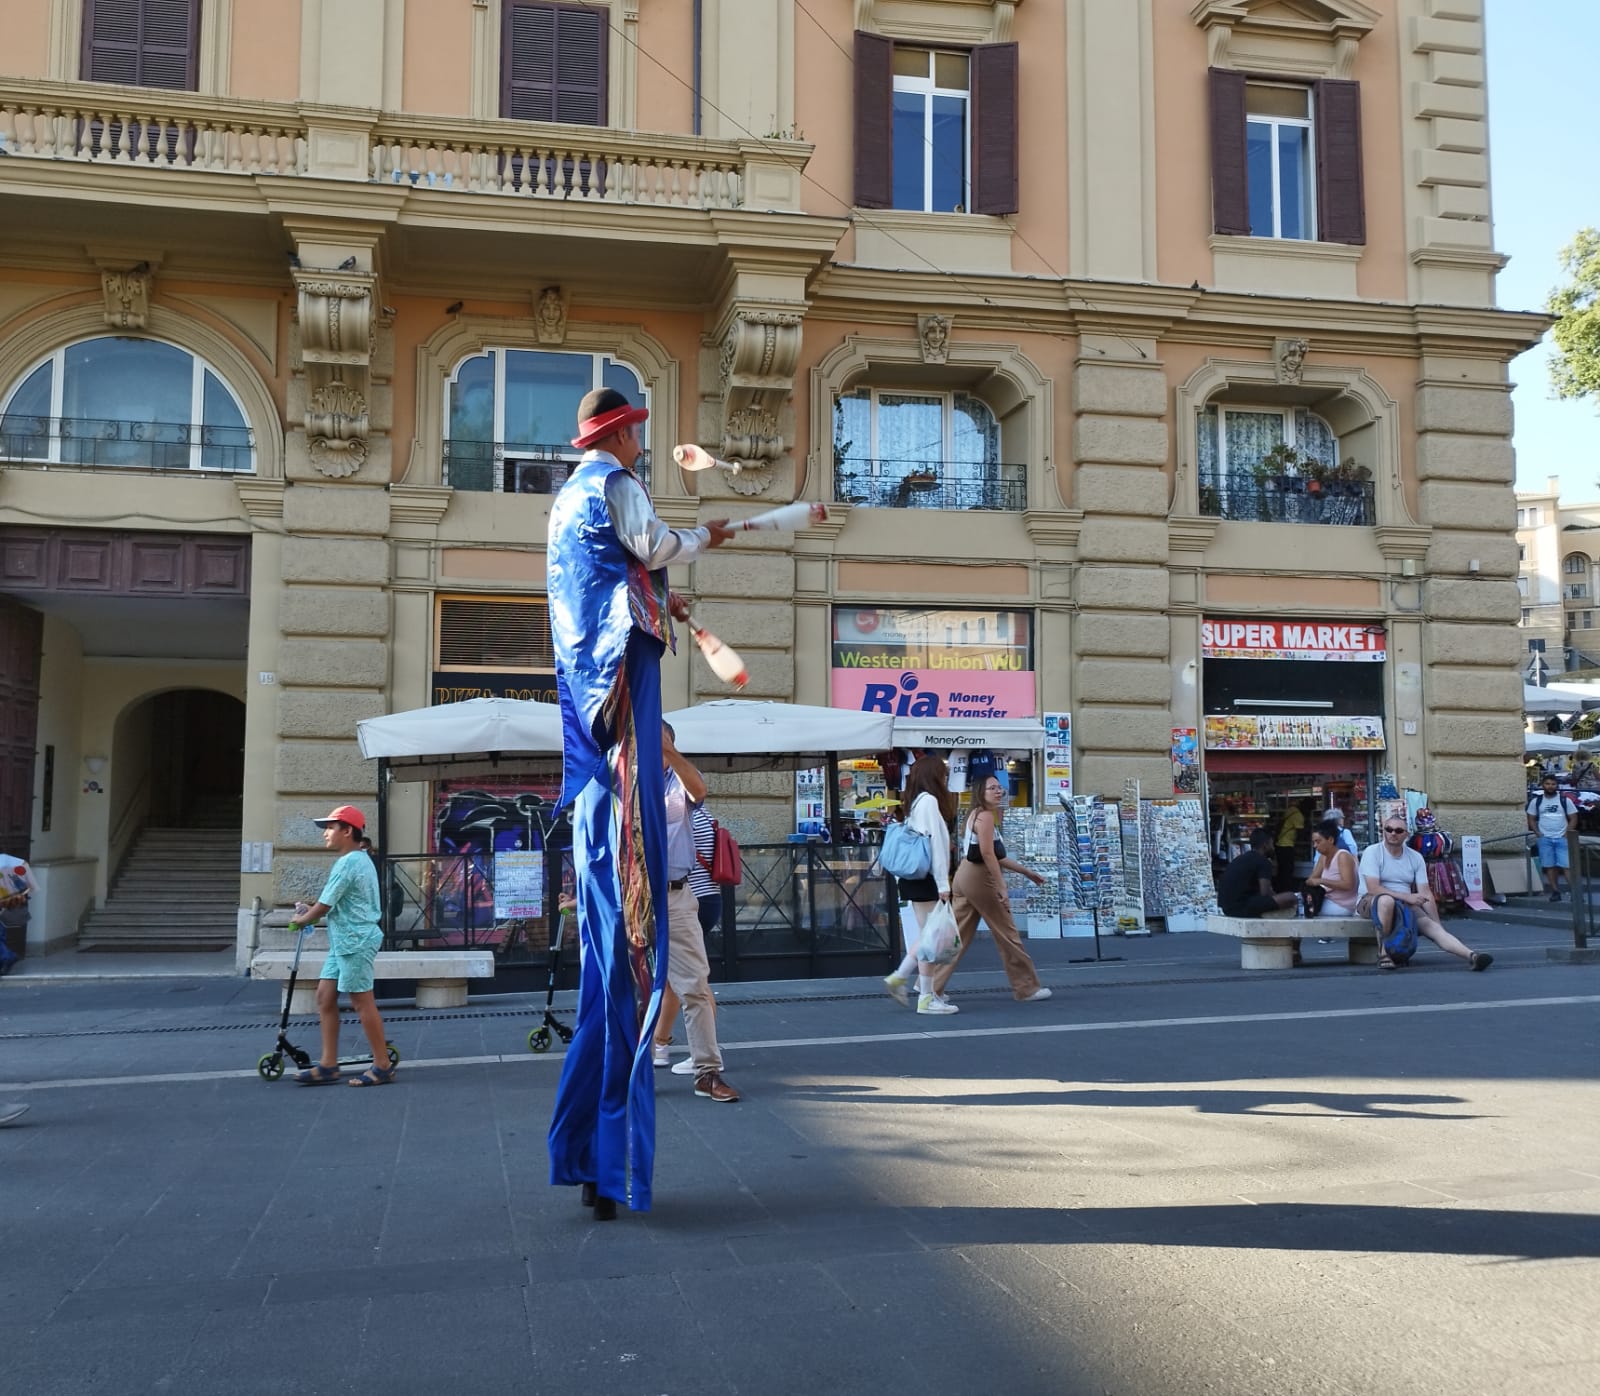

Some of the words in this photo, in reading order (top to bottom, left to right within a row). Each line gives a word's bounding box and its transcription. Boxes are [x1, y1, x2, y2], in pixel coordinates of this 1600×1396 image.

[1201, 623, 1277, 648] SUPER
[1282, 625, 1377, 650] MARKET
[840, 651, 921, 669] Western
[929, 653, 984, 670] Union
[990, 654, 1022, 671] WU
[861, 672, 940, 717] Ria
[949, 692, 995, 706] Money
[949, 707, 1008, 718] Transfer
[924, 735, 985, 746] MoneyGram
